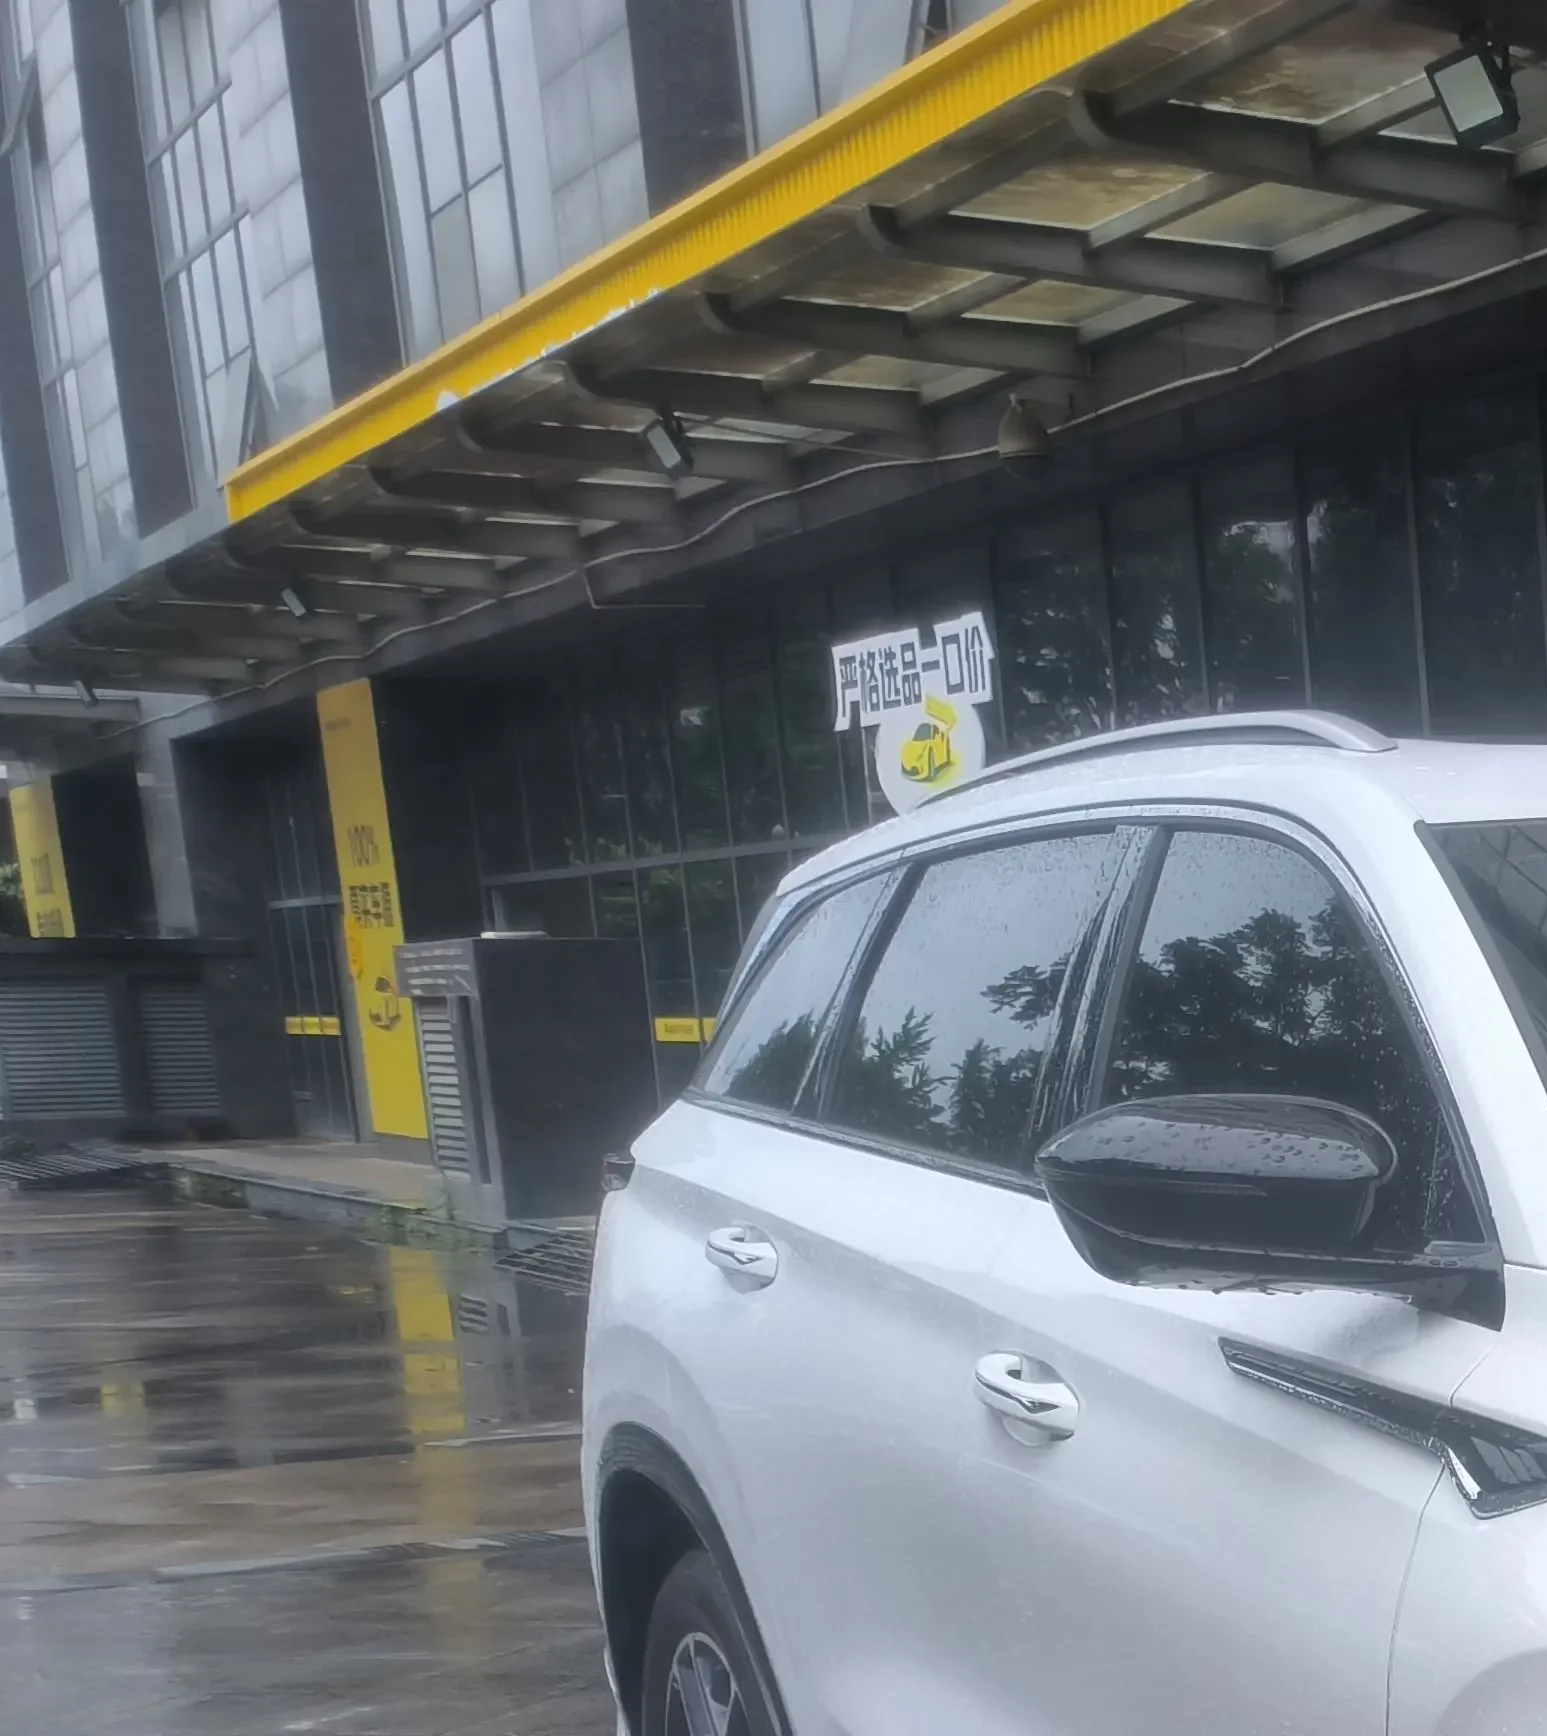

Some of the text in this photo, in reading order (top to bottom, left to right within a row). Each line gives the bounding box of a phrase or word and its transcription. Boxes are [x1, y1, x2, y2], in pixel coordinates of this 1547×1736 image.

[838, 624, 988, 718] 严格选品一口价
